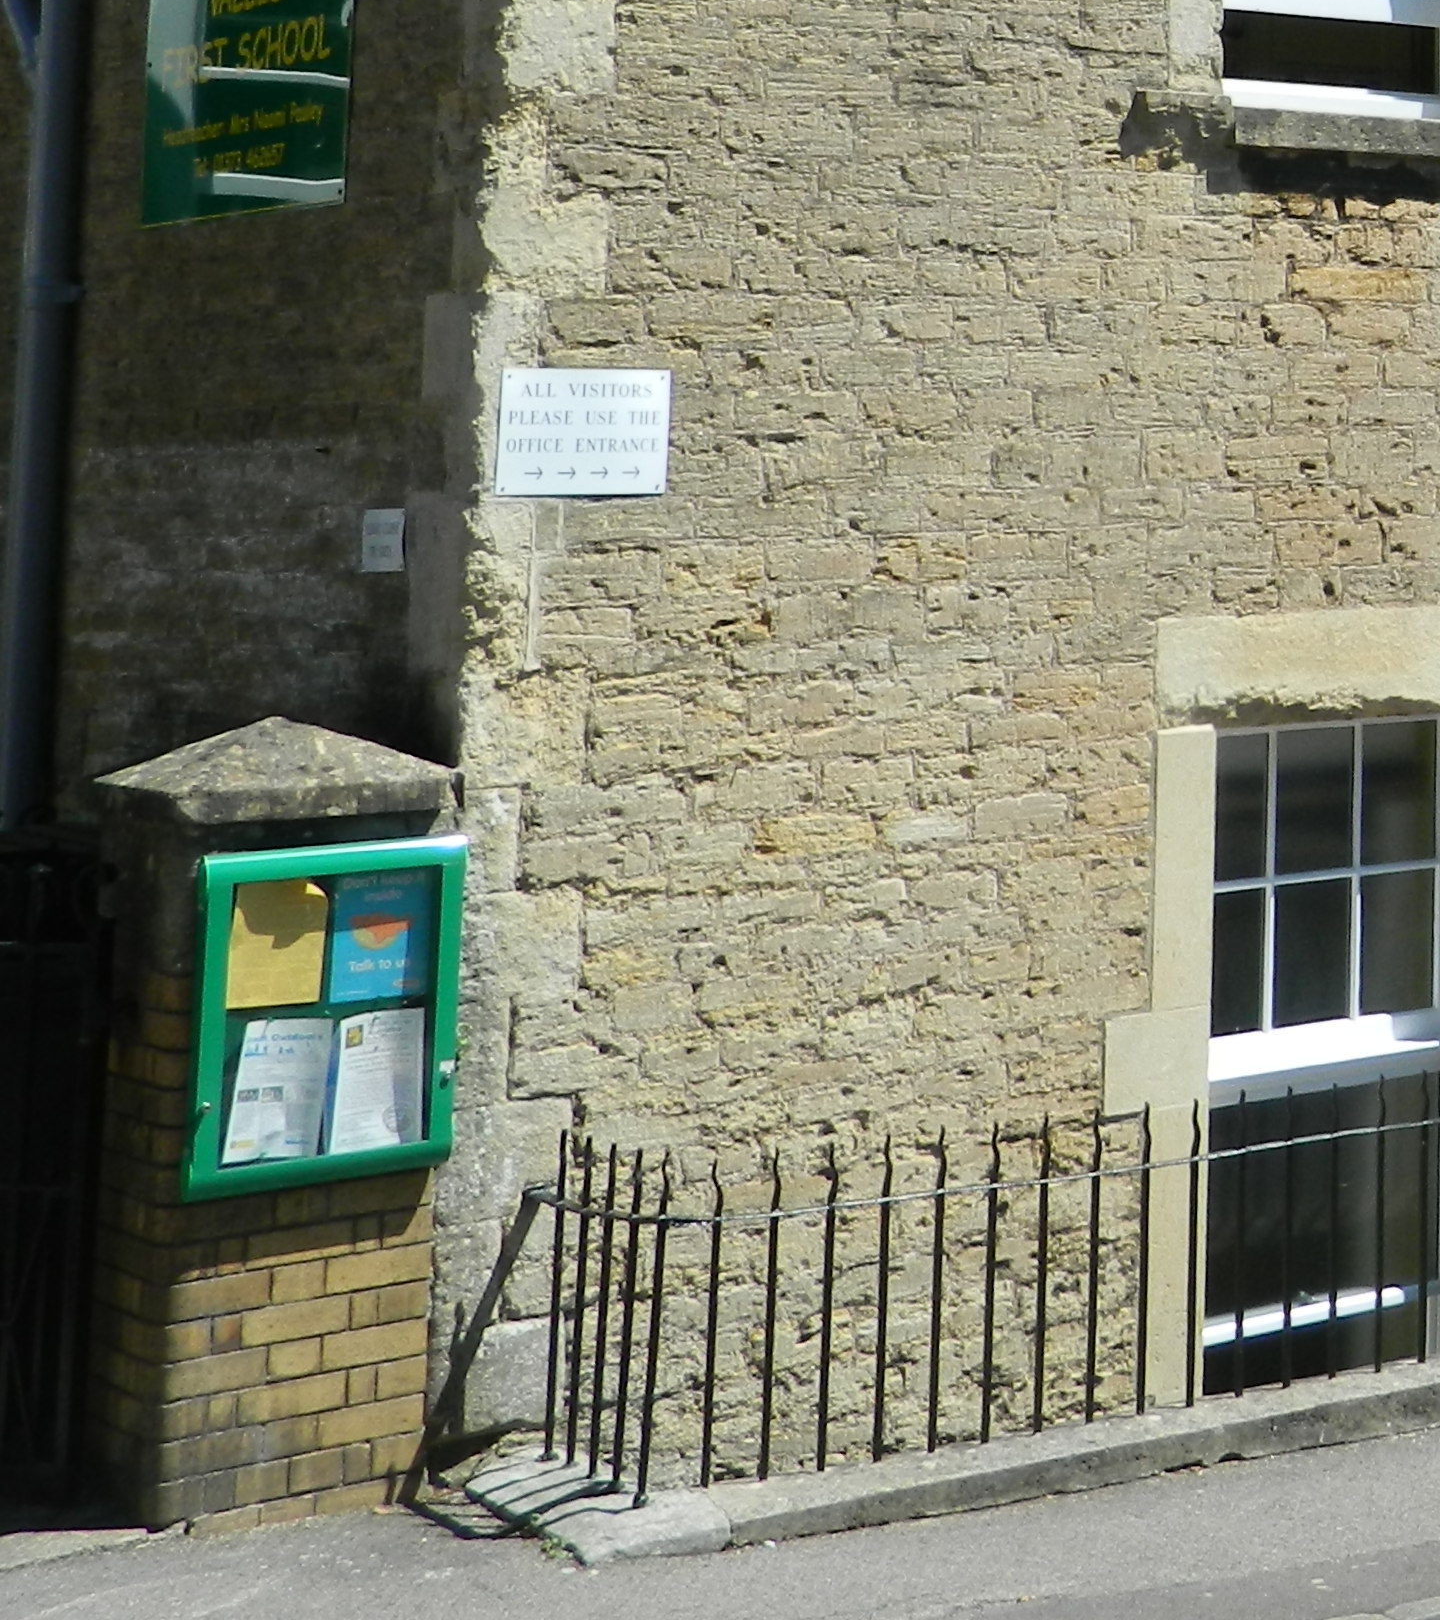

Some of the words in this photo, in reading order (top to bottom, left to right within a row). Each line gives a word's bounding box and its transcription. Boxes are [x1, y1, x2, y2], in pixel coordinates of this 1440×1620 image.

[162, 37, 229, 87] FIRST
[236, 13, 332, 73] SCHOOL
[521, 382, 557, 398] ALL
[568, 382, 654, 399] VISITORS
[507, 410, 574, 426] PLEASE
[585, 410, 617, 426] USE
[627, 410, 661, 426] THE
[505, 437, 564, 453] OFFICE
[575, 437, 660, 453] ENTRANCE
[348, 959, 375, 972] Talk
